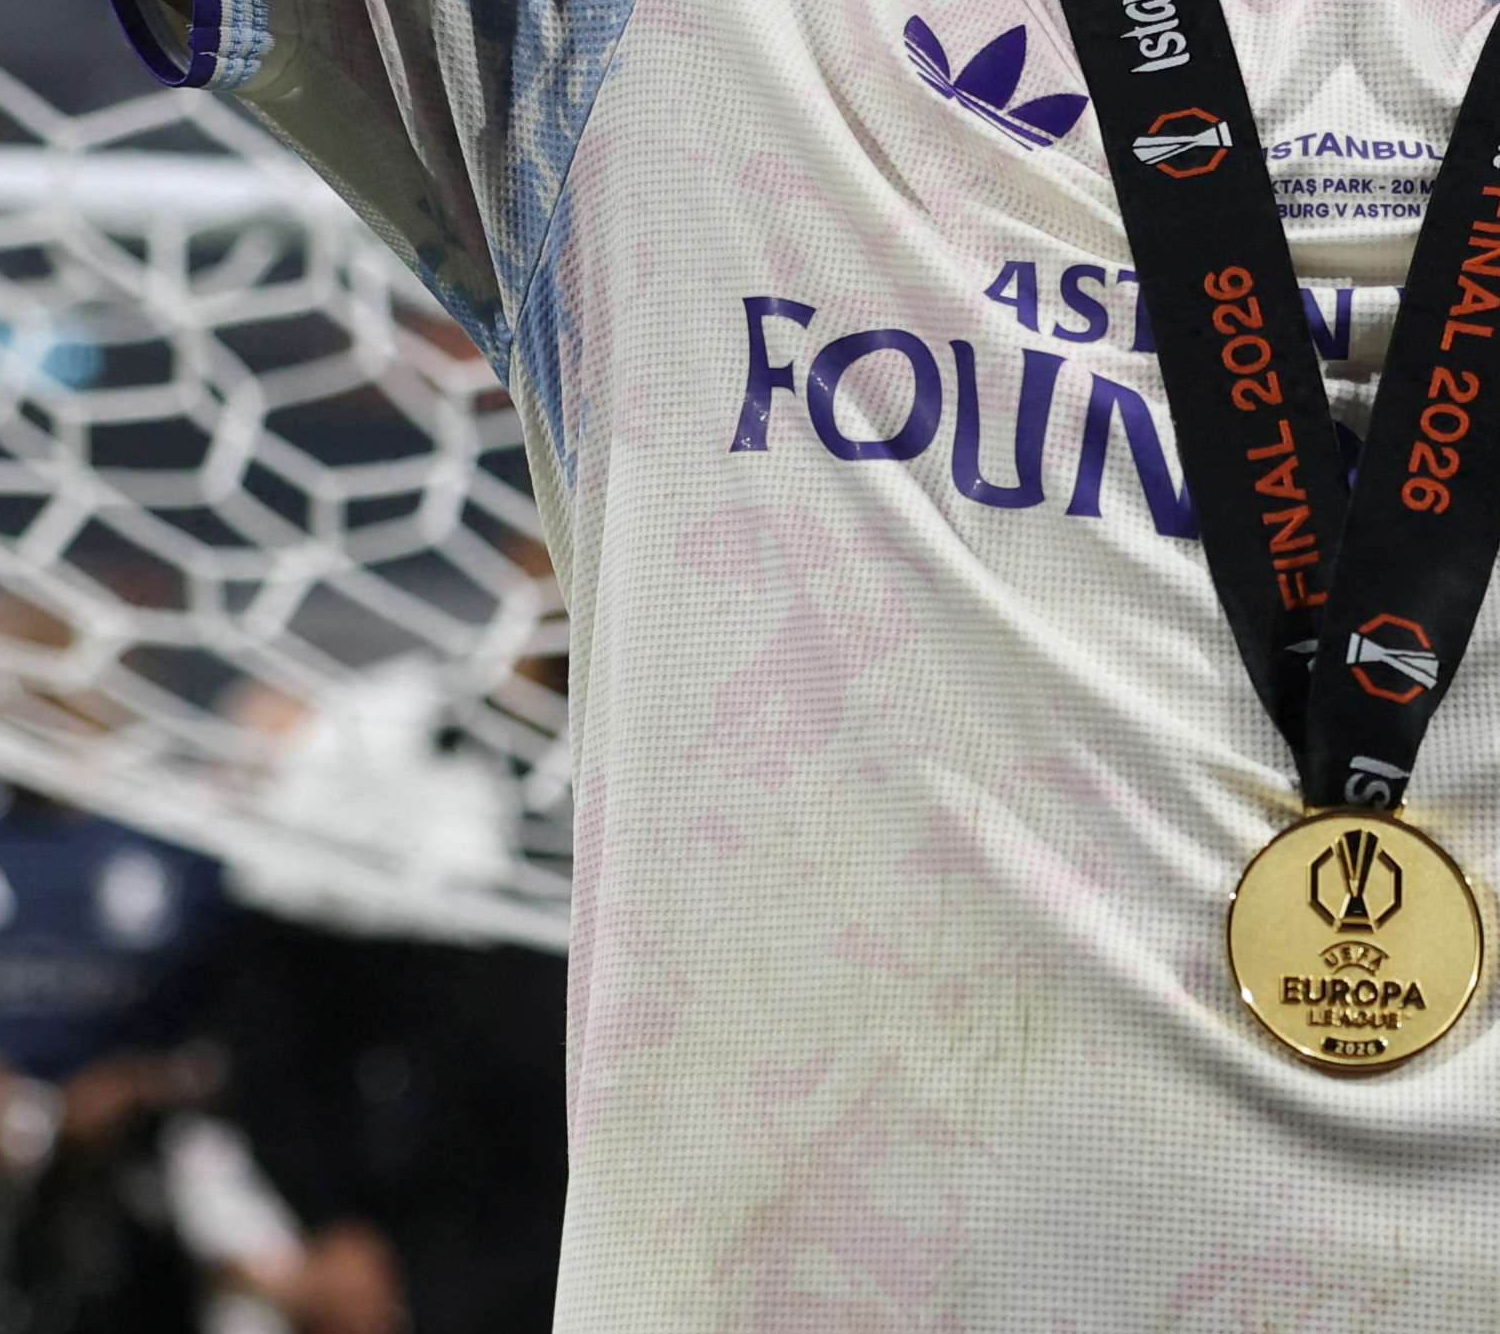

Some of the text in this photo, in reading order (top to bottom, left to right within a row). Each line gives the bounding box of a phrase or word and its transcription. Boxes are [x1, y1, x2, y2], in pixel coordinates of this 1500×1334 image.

[1271, 178, 1317, 197] KTAŞ
[1322, 178, 1373, 194] PARK
[1391, 179, 1415, 195] 20
[1275, 203, 1421, 218] BURG V ASTON
[984, 261, 1352, 361] ASTN
[1203, 265, 1284, 411] 2026
[1401, 366, 1481, 514] 2026
[1246, 419, 1329, 610] FINAL
[1323, 947, 1385, 971] UEFA
[1280, 975, 1428, 1011] EUROPA
[1308, 1009, 1401, 1031] LEAGUE
